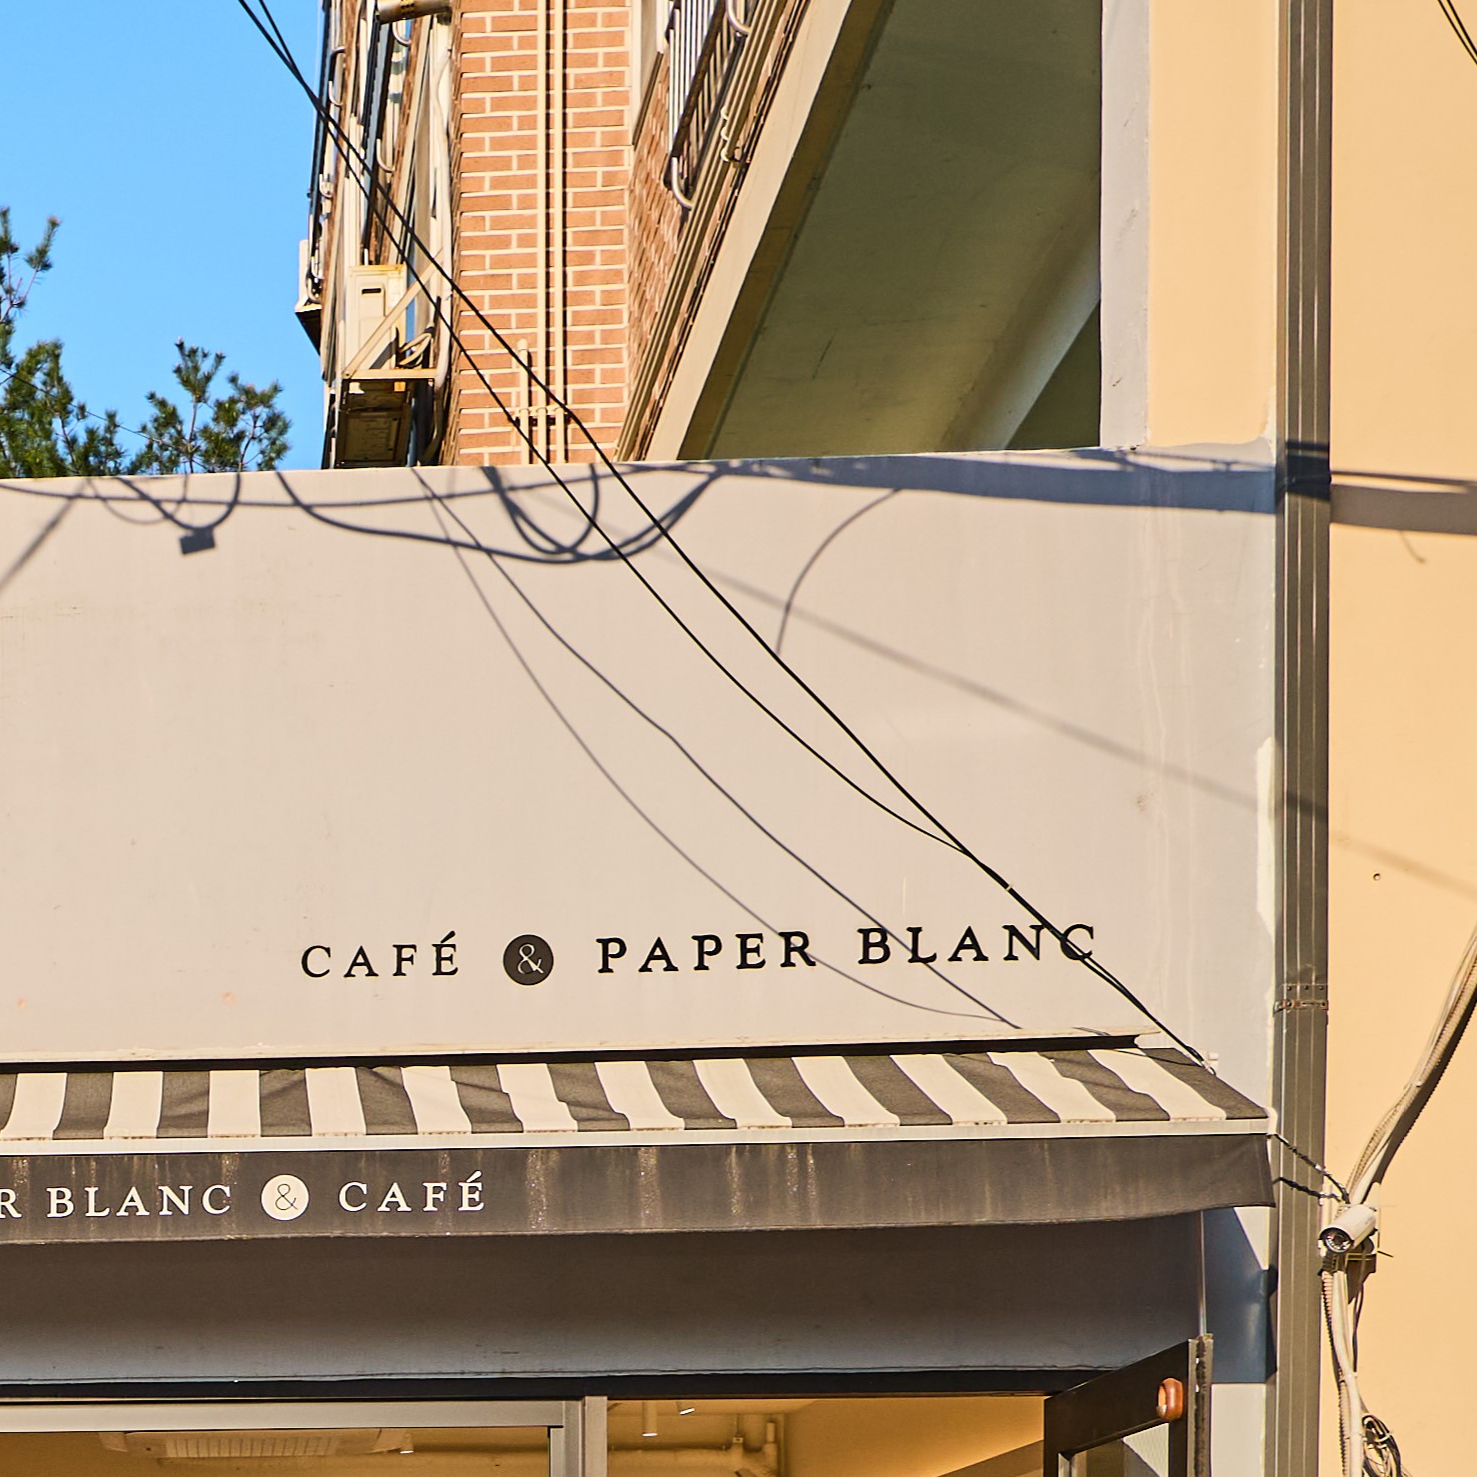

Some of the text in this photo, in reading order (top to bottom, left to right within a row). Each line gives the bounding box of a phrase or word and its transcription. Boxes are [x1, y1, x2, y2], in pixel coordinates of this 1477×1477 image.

[302, 930, 459, 978] CAFÉ
[595, 930, 817, 974] PAPER
[857, 923, 1094, 965] BLANC
[46, 1184, 233, 1218] BLANC
[339, 1170, 485, 1212] CAFÉ
